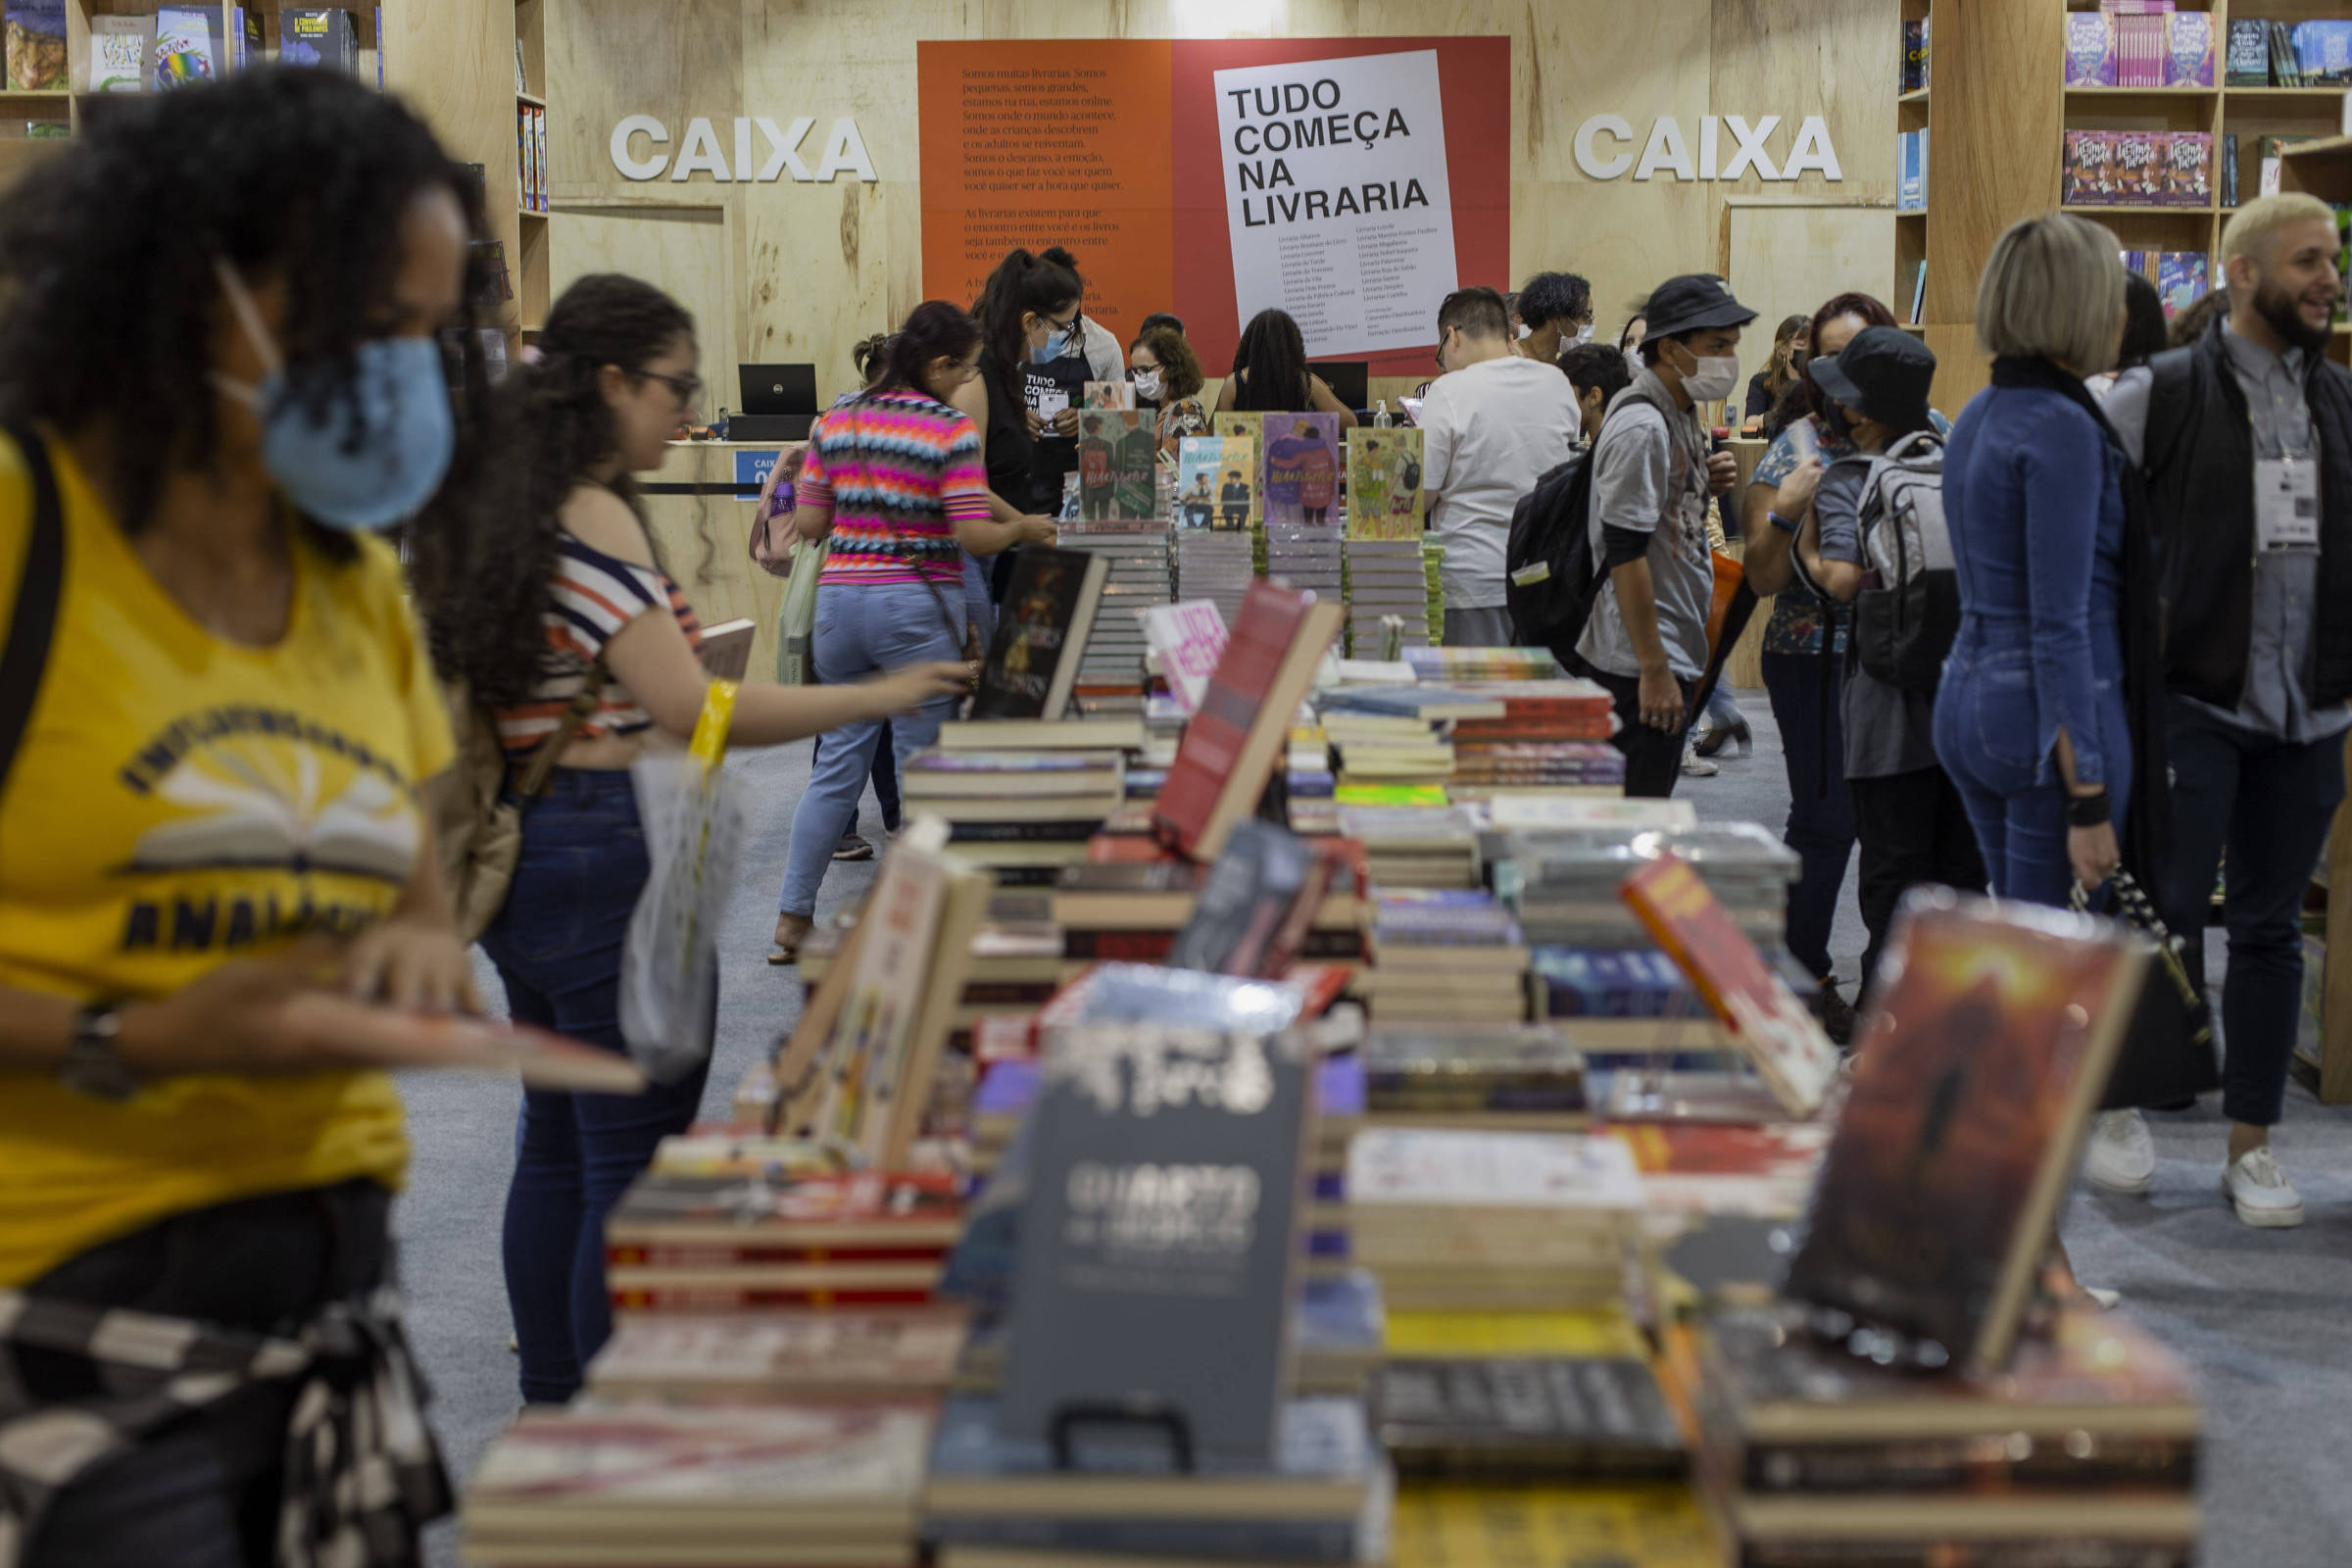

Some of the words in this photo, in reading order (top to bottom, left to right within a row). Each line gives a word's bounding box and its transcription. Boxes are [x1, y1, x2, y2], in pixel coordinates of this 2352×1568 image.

[962, 68, 994, 78] Somos
[998, 68, 1029, 78] muitas
[1074, 68, 1106, 78] Somos
[1013, 83, 1045, 92] somos
[962, 95, 1002, 107] estamos
[1040, 95, 1078, 107] estamos
[1228, 78, 1341, 119] TUDO
[962, 110, 995, 120] Somos
[998, 110, 1021, 120] onde
[1034, 110, 1068, 120] mundo
[962, 124, 988, 134] onde
[1045, 124, 1098, 134] descobrem
[1234, 108, 1410, 155] COMEÇA
[610, 115, 879, 182] CAIXA
[984, 139, 1019, 148] adultos
[1574, 113, 1842, 181] CAIXA
[964, 153, 996, 163] Somos
[1006, 169, 1024, 177] que
[1027, 167, 1040, 176] faz
[1043, 167, 1064, 176] você
[1084, 169, 1112, 177] quem
[1239, 159, 1295, 191] NA
[964, 180, 986, 190] você
[989, 180, 1017, 191] quiser
[1046, 180, 1067, 190] hora
[1070, 182, 1088, 191] que
[1243, 178, 1430, 226] LIVRARIA
[965, 209, 976, 219] As
[979, 209, 1016, 219] livrarias
[1019, 209, 1056, 219] existem
[1059, 210, 1080, 220] para
[1083, 210, 1101, 220] que
[973, 221, 1016, 231] encontro
[1019, 221, 1045, 231] entre
[1048, 221, 1069, 231] você
[1093, 221, 1119, 231] livros
[965, 235, 982, 246] seja
[985, 235, 1025, 245] também
[1036, 235, 1080, 245] encontro
[1083, 235, 1107, 245] entre
[965, 249, 987, 259] você
[755, 460, 775, 468] CAIX
